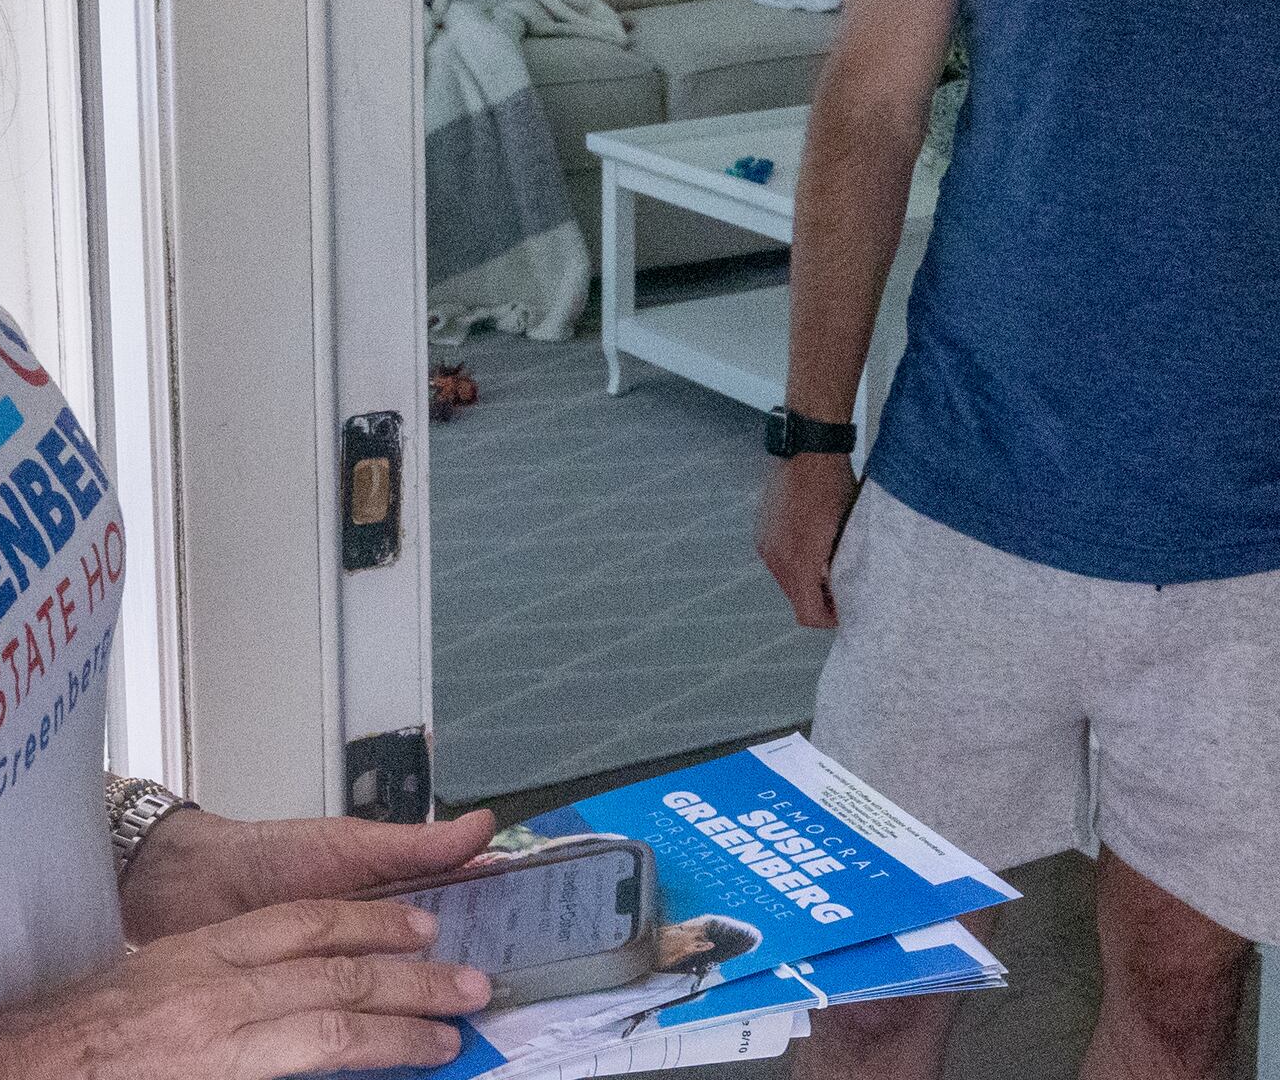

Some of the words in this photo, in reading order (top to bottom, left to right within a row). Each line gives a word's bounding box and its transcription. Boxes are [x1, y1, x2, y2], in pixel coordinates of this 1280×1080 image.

[644, 833, 725, 888] DISTRICT
[719, 891, 746, 909] 53
[648, 810, 683, 836] FOR
[680, 836, 735, 874] STATE
[731, 875, 796, 920] HOUSE
[662, 791, 854, 924] GREENBERG
[737, 810, 846, 878] SUSIE
[757, 790, 889, 880] DEMOCRAT
[738, 1030, 751, 1053] 8/10
